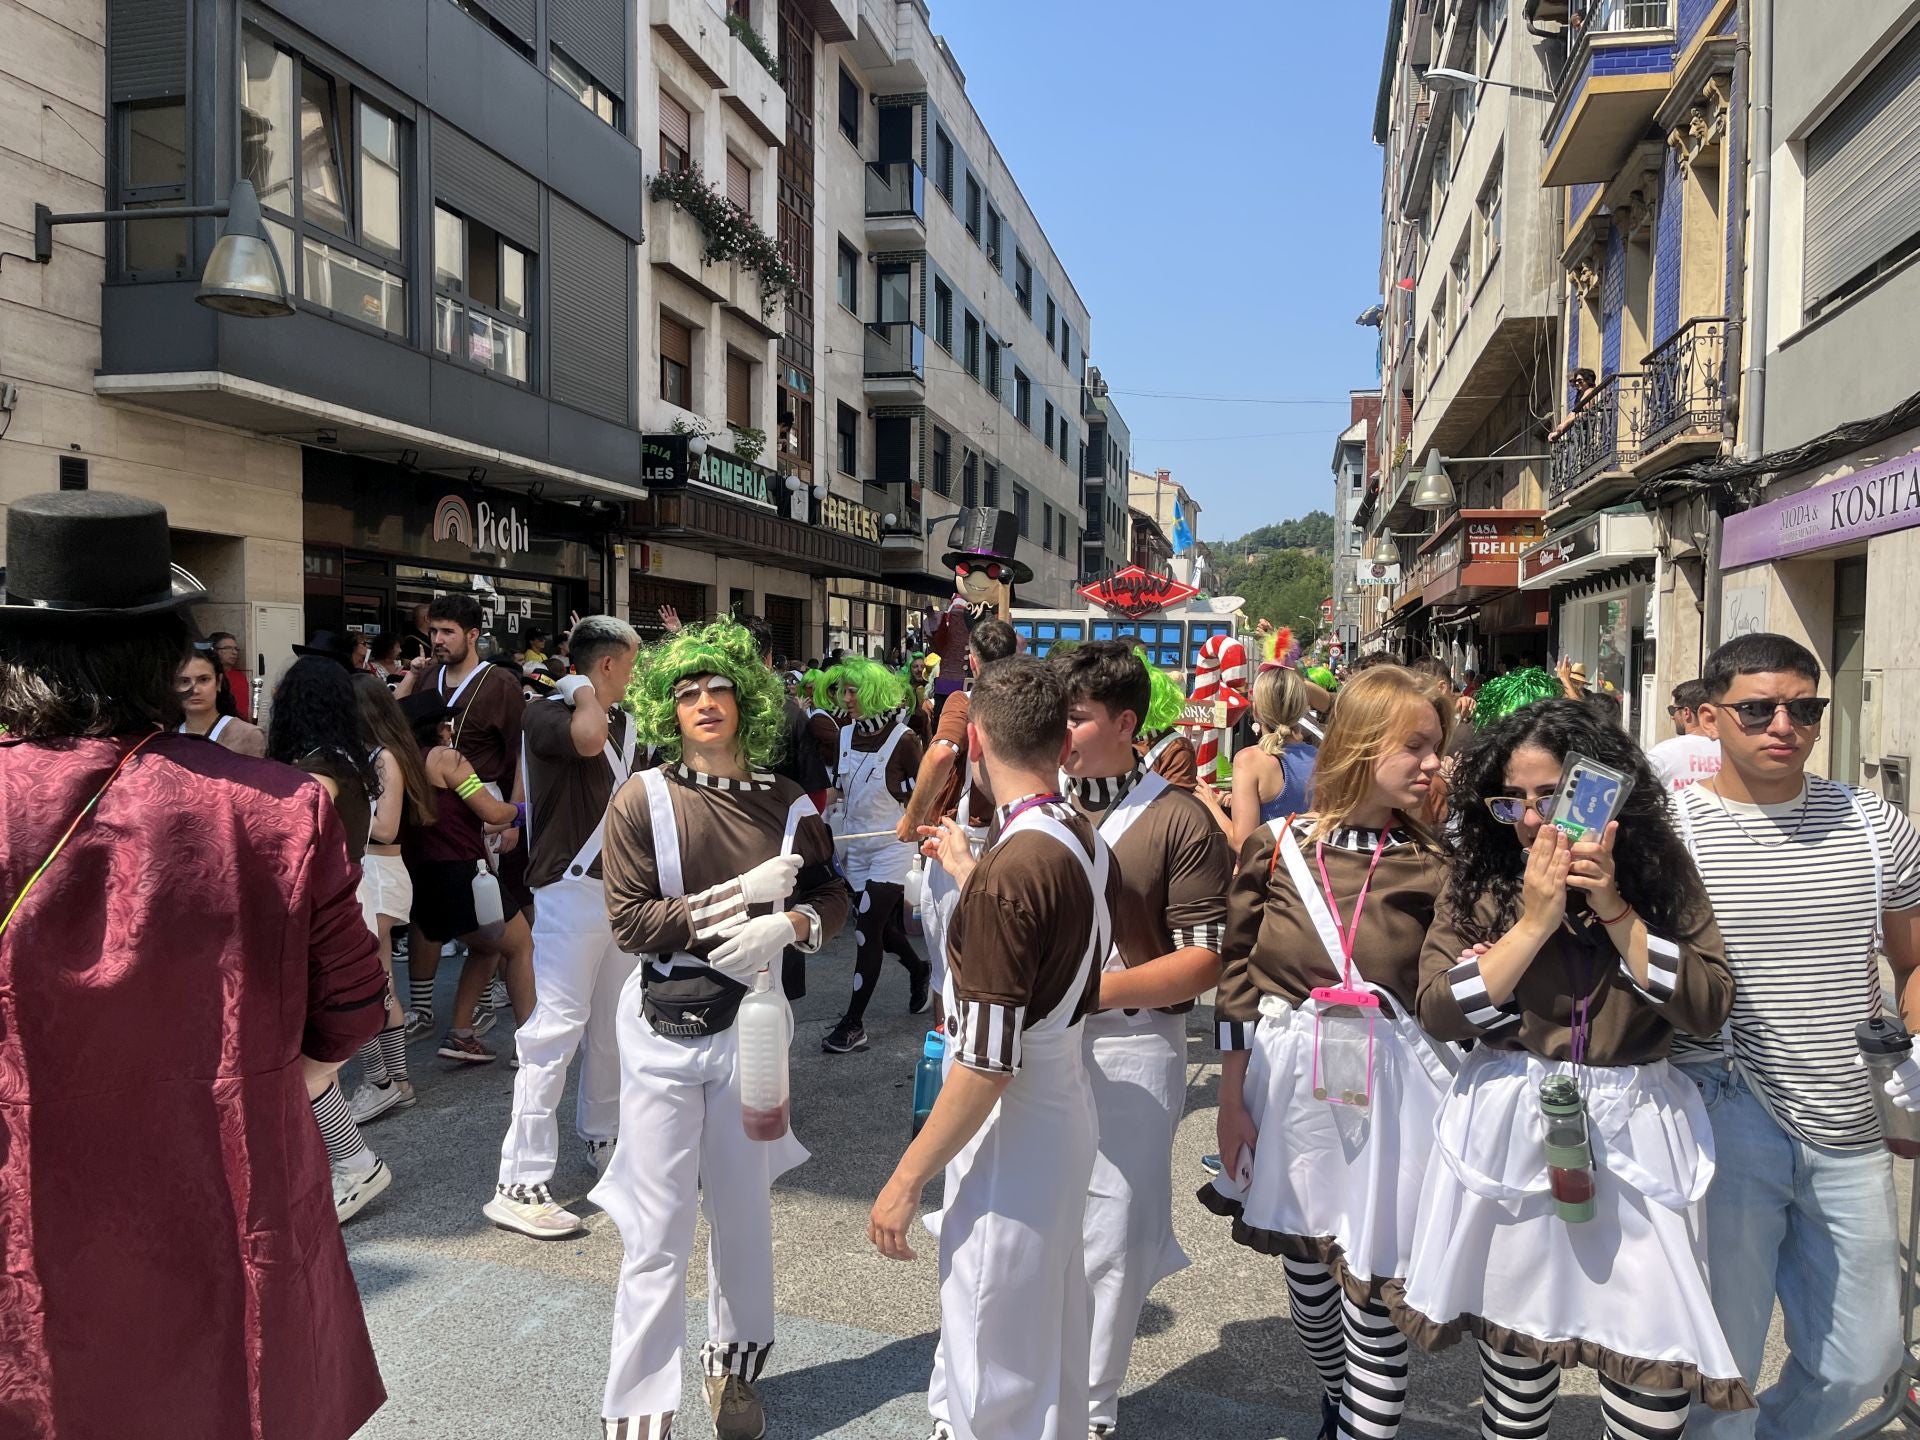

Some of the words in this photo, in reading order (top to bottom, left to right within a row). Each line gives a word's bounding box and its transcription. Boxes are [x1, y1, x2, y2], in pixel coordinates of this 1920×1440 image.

[698, 453, 769, 502] ARMERIA
[477, 501, 529, 553] Pichi
[1469, 524, 1498, 534] CASA
[1780, 504, 1810, 531] MODA
[1556, 823, 1580, 838] Orbit
